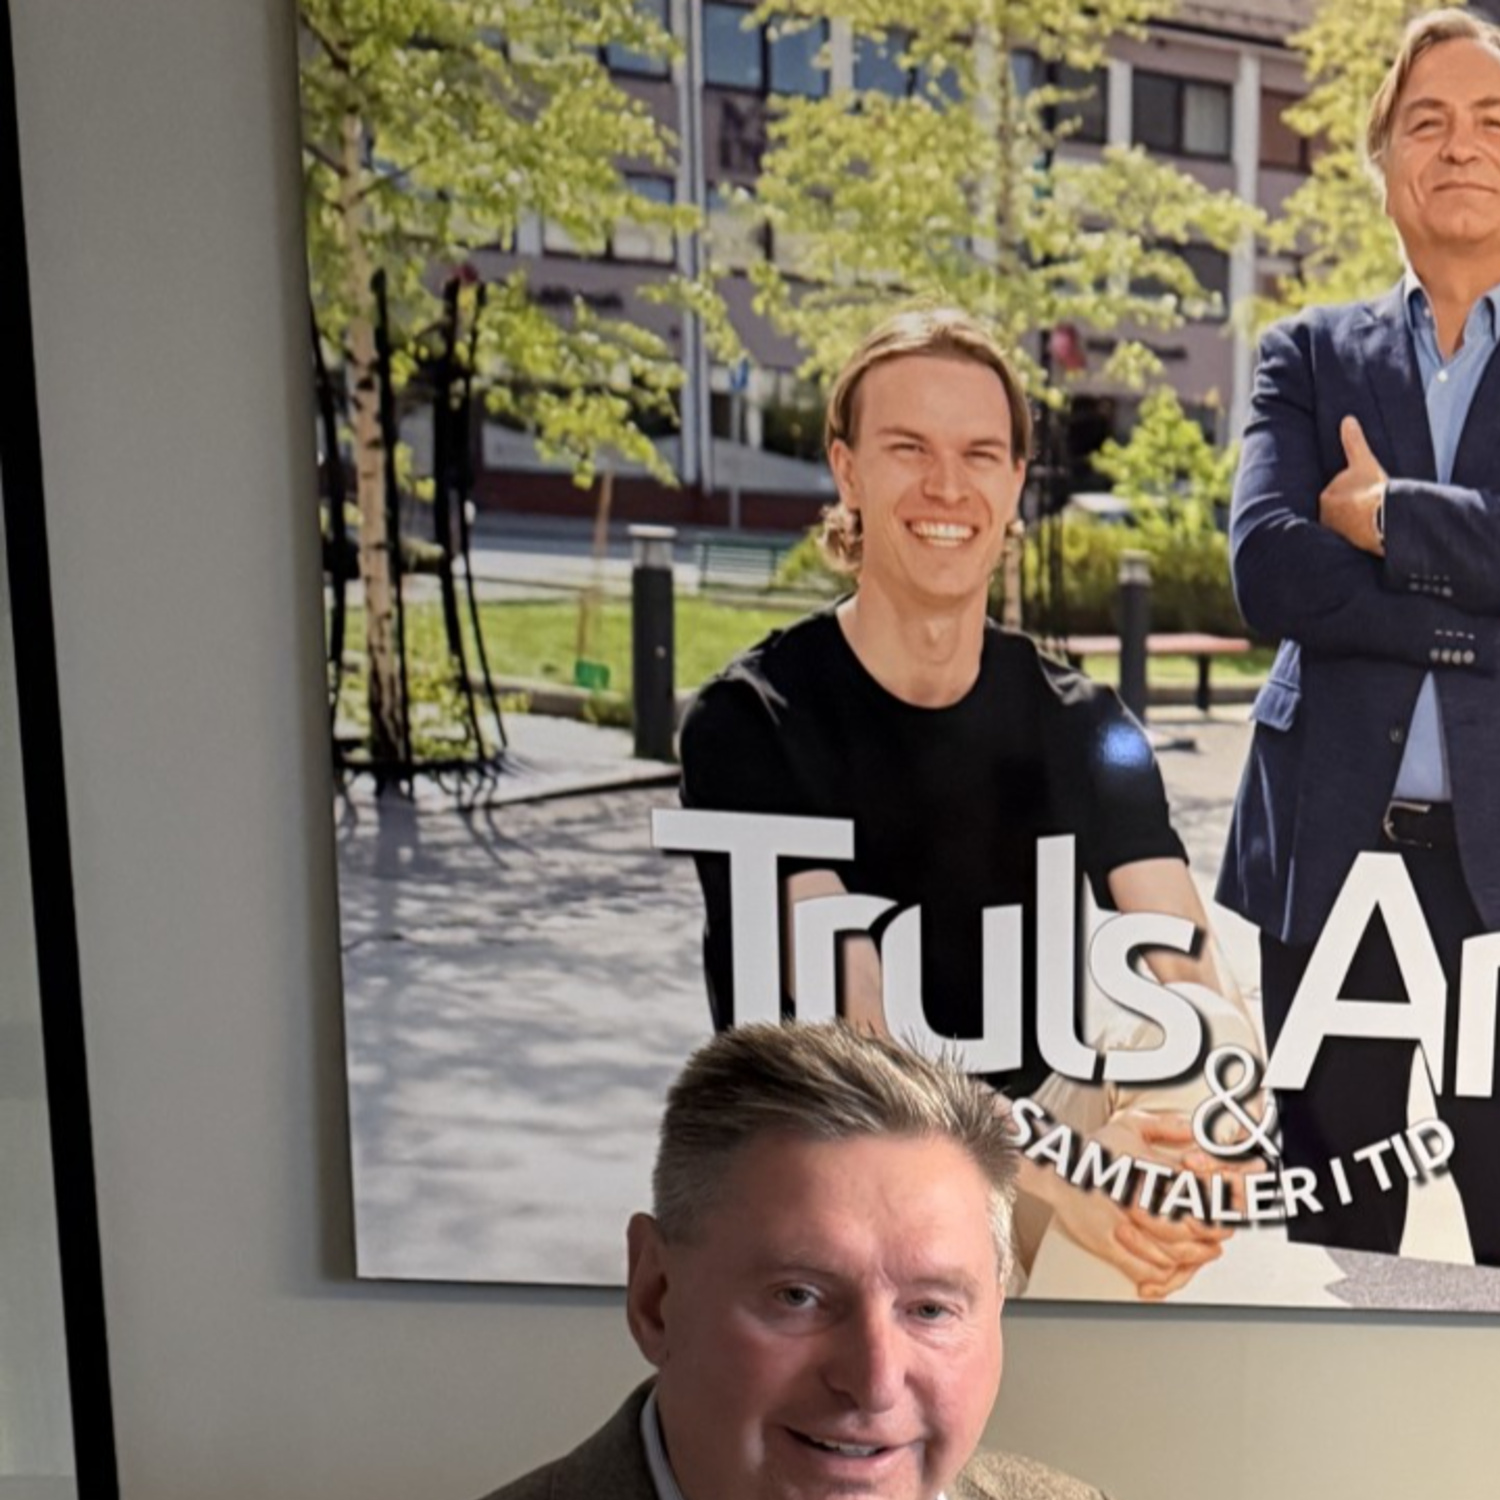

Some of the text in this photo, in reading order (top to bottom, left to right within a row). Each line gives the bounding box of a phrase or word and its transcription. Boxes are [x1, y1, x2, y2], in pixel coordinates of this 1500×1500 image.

[652, 808, 1202, 1082] Truls
[1192, 1045, 1281, 1158] &
[1008, 1098, 1455, 1221] SAMTALER I TID
